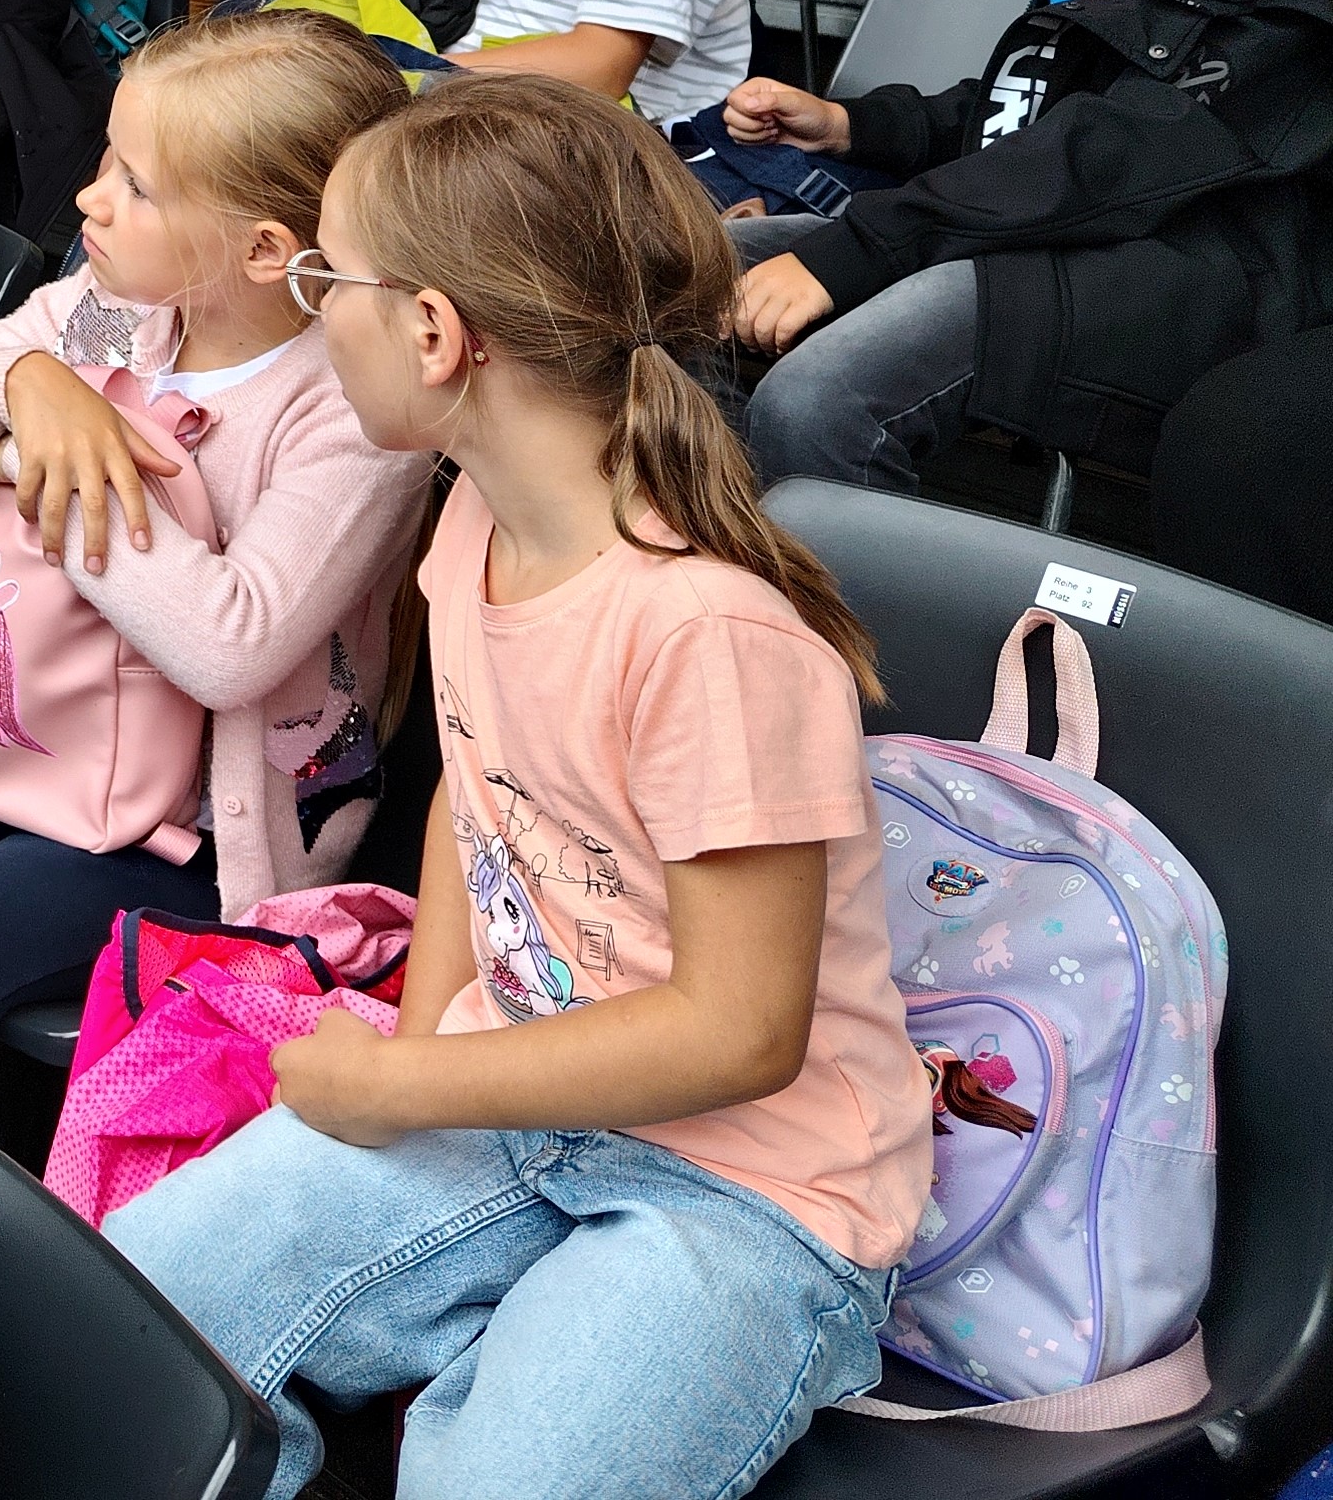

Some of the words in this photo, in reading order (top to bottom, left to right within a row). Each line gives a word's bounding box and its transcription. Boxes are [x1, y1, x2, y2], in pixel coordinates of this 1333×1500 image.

[1054, 577, 1079, 591] Reihe
[1086, 586, 1093, 594] 3
[1049, 590, 1070, 603] Platz
[1081, 600, 1093, 609] 92
